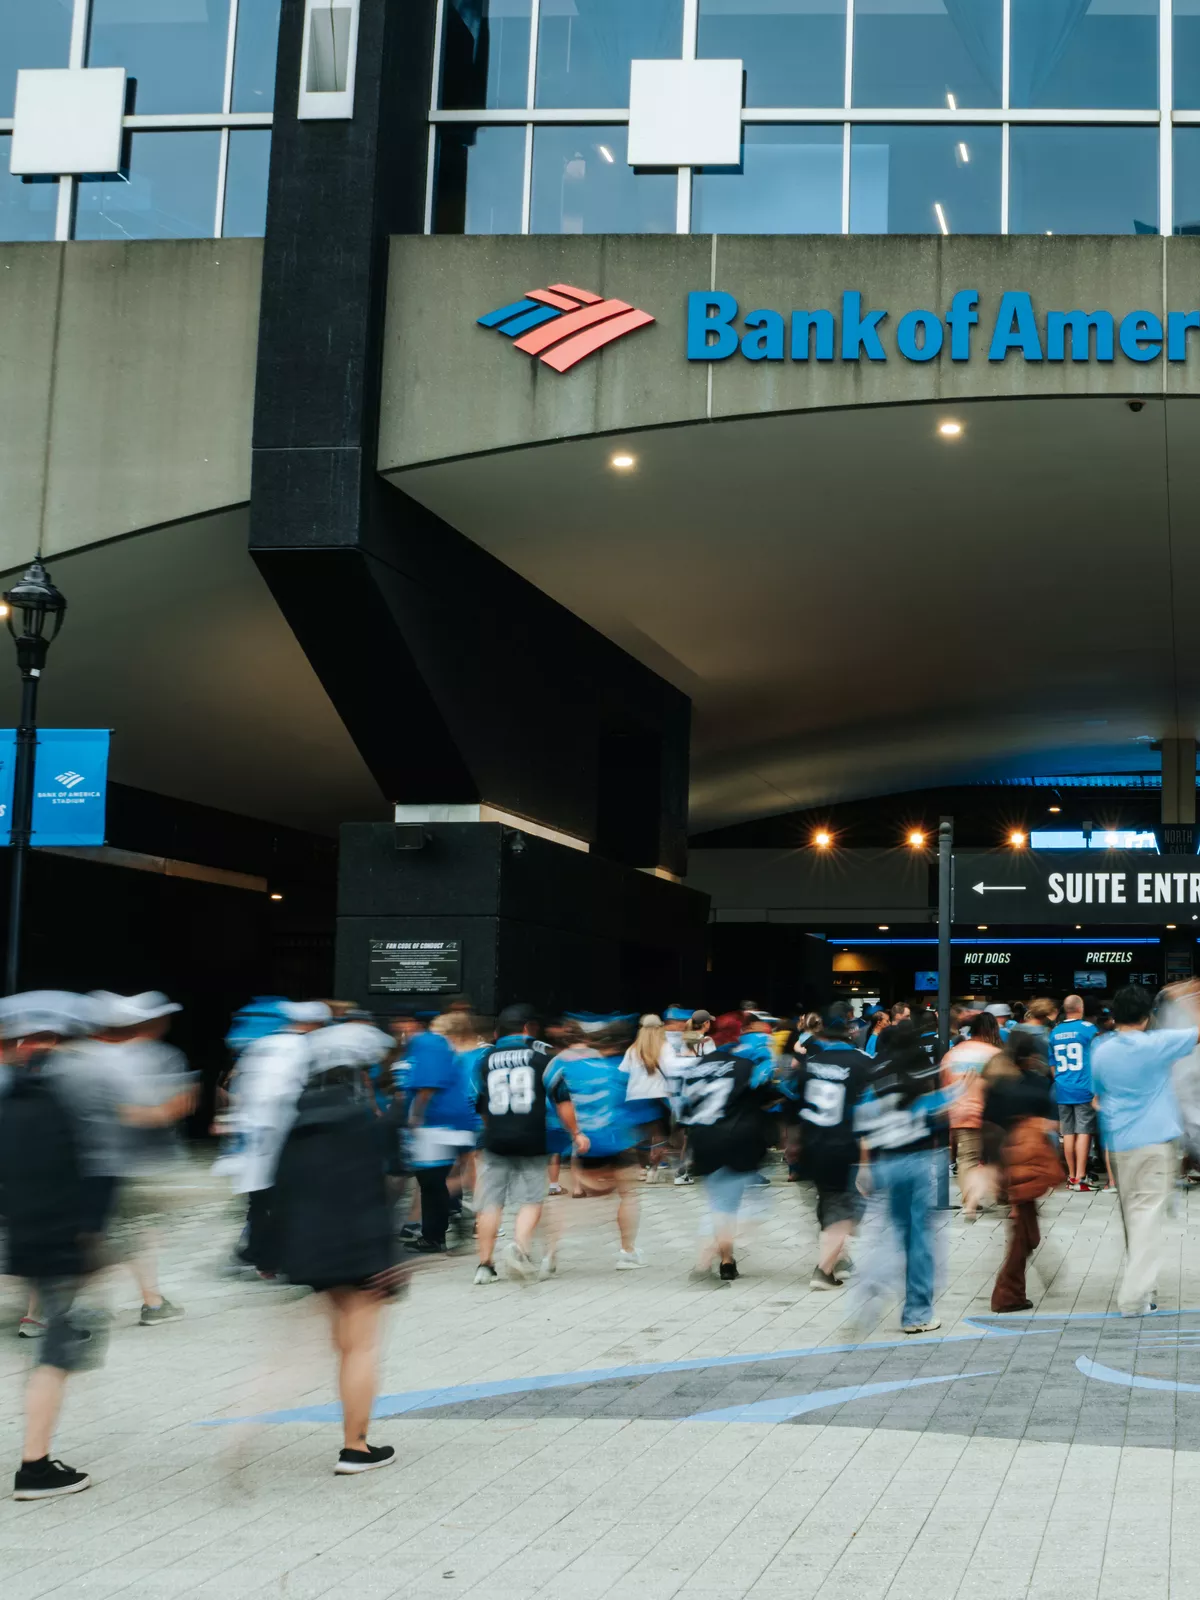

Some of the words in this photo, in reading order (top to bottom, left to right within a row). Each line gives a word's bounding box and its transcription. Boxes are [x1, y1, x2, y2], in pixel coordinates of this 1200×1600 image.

[687, 290, 889, 362] Bank
[897, 289, 980, 362] of
[1048, 872, 1127, 904] SUITE
[964, 952, 983, 964] HOT
[984, 952, 1011, 964] DOGS
[1086, 951, 1133, 963] PRETZELS
[1053, 1042, 1084, 1073] 59
